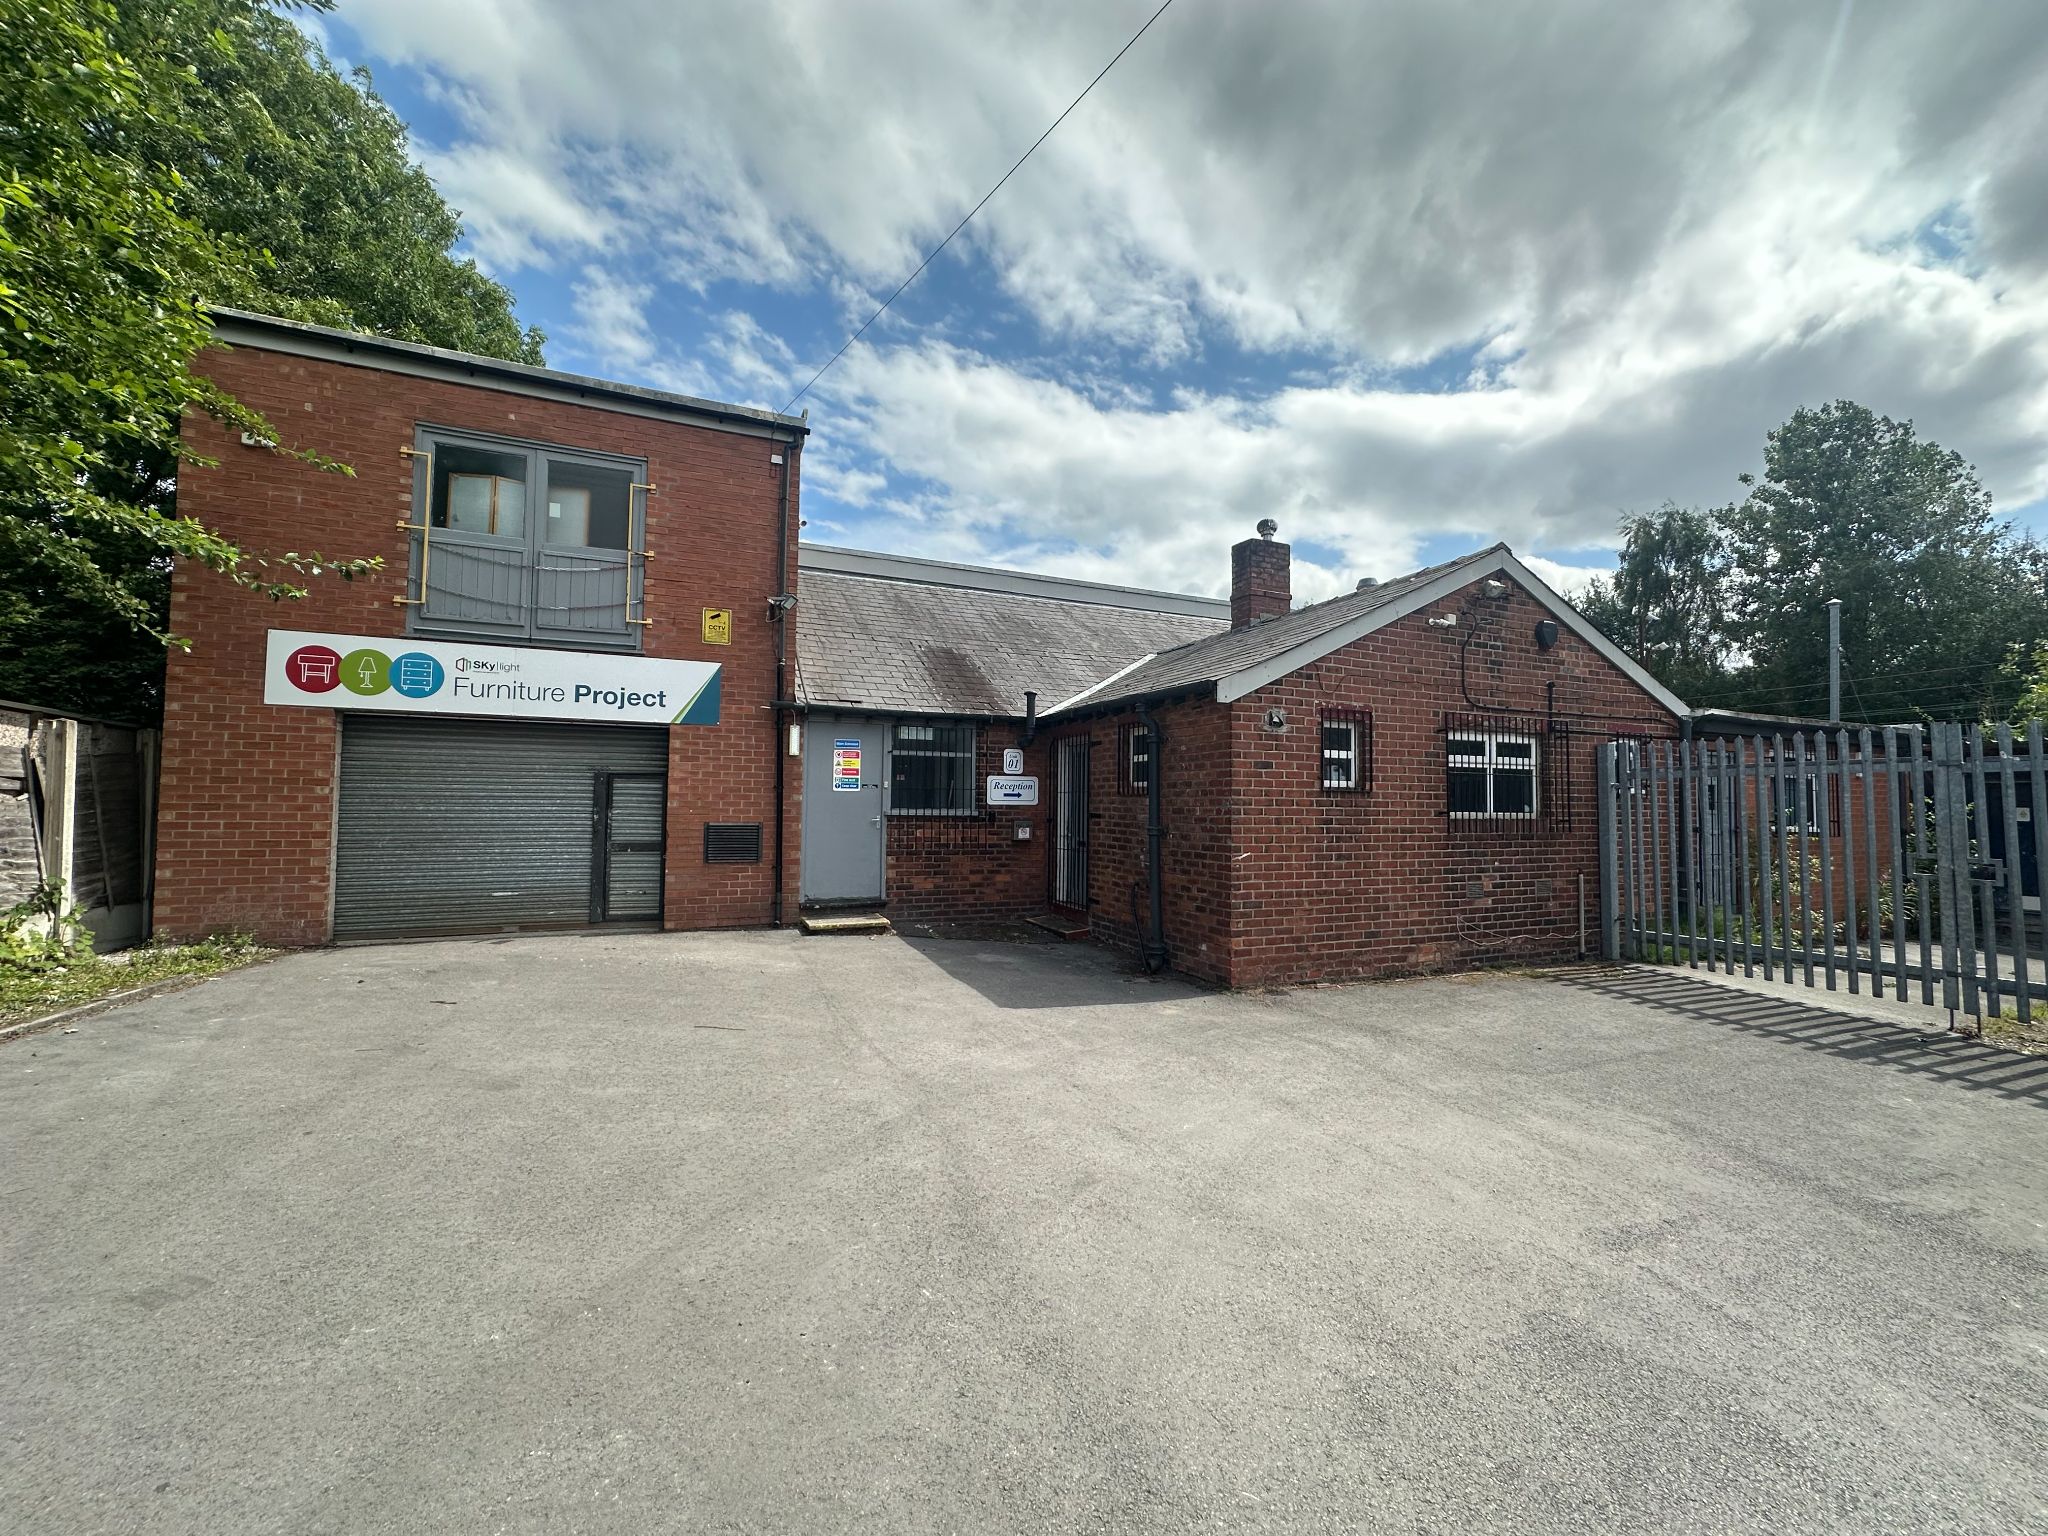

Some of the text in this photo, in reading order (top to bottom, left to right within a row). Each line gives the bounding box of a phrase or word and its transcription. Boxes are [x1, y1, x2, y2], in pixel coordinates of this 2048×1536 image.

[454, 677, 667, 709] Furniture Project
[1007, 758, 1019, 769] 01
[993, 781, 1033, 792] Reception
